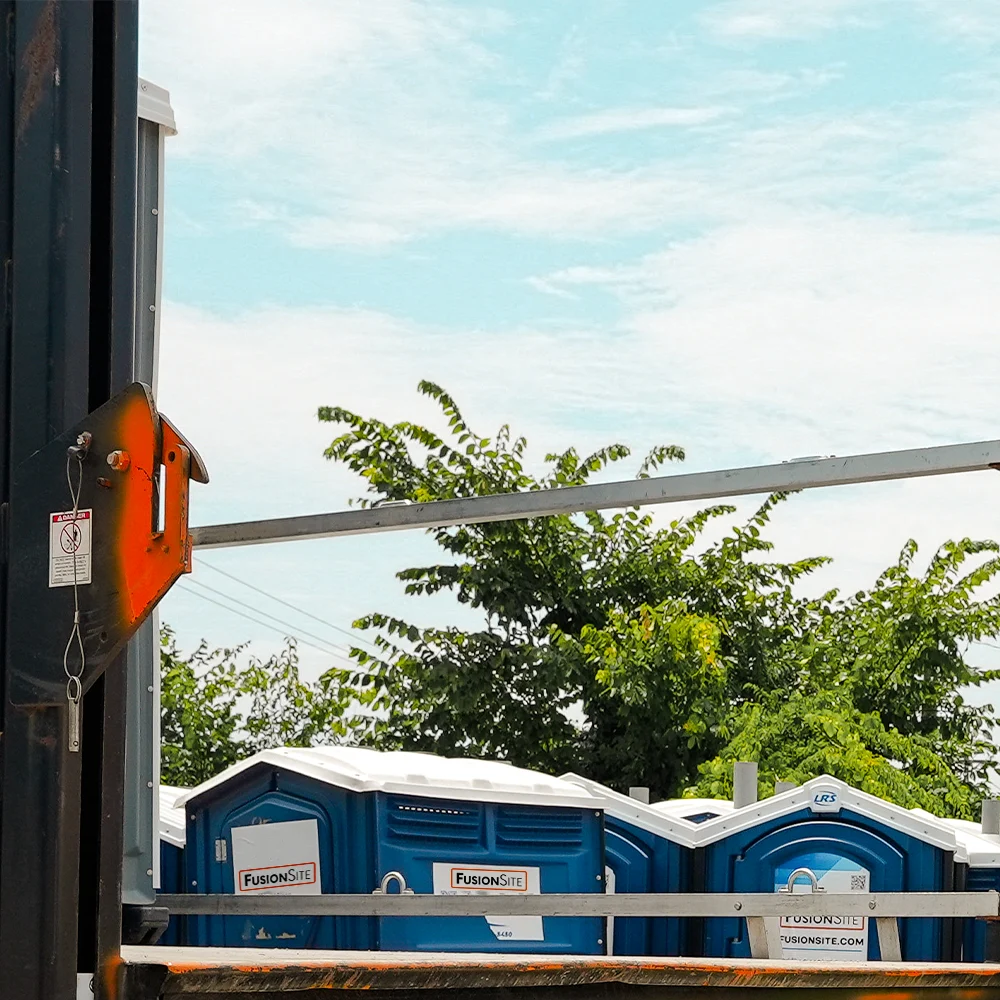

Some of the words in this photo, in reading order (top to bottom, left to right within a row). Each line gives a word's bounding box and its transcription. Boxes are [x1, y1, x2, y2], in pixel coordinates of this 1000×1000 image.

[814, 794, 837, 803] LRS
[244, 868, 311, 887] FUSIONSITE
[456, 872, 523, 887] FUSIONSITE
